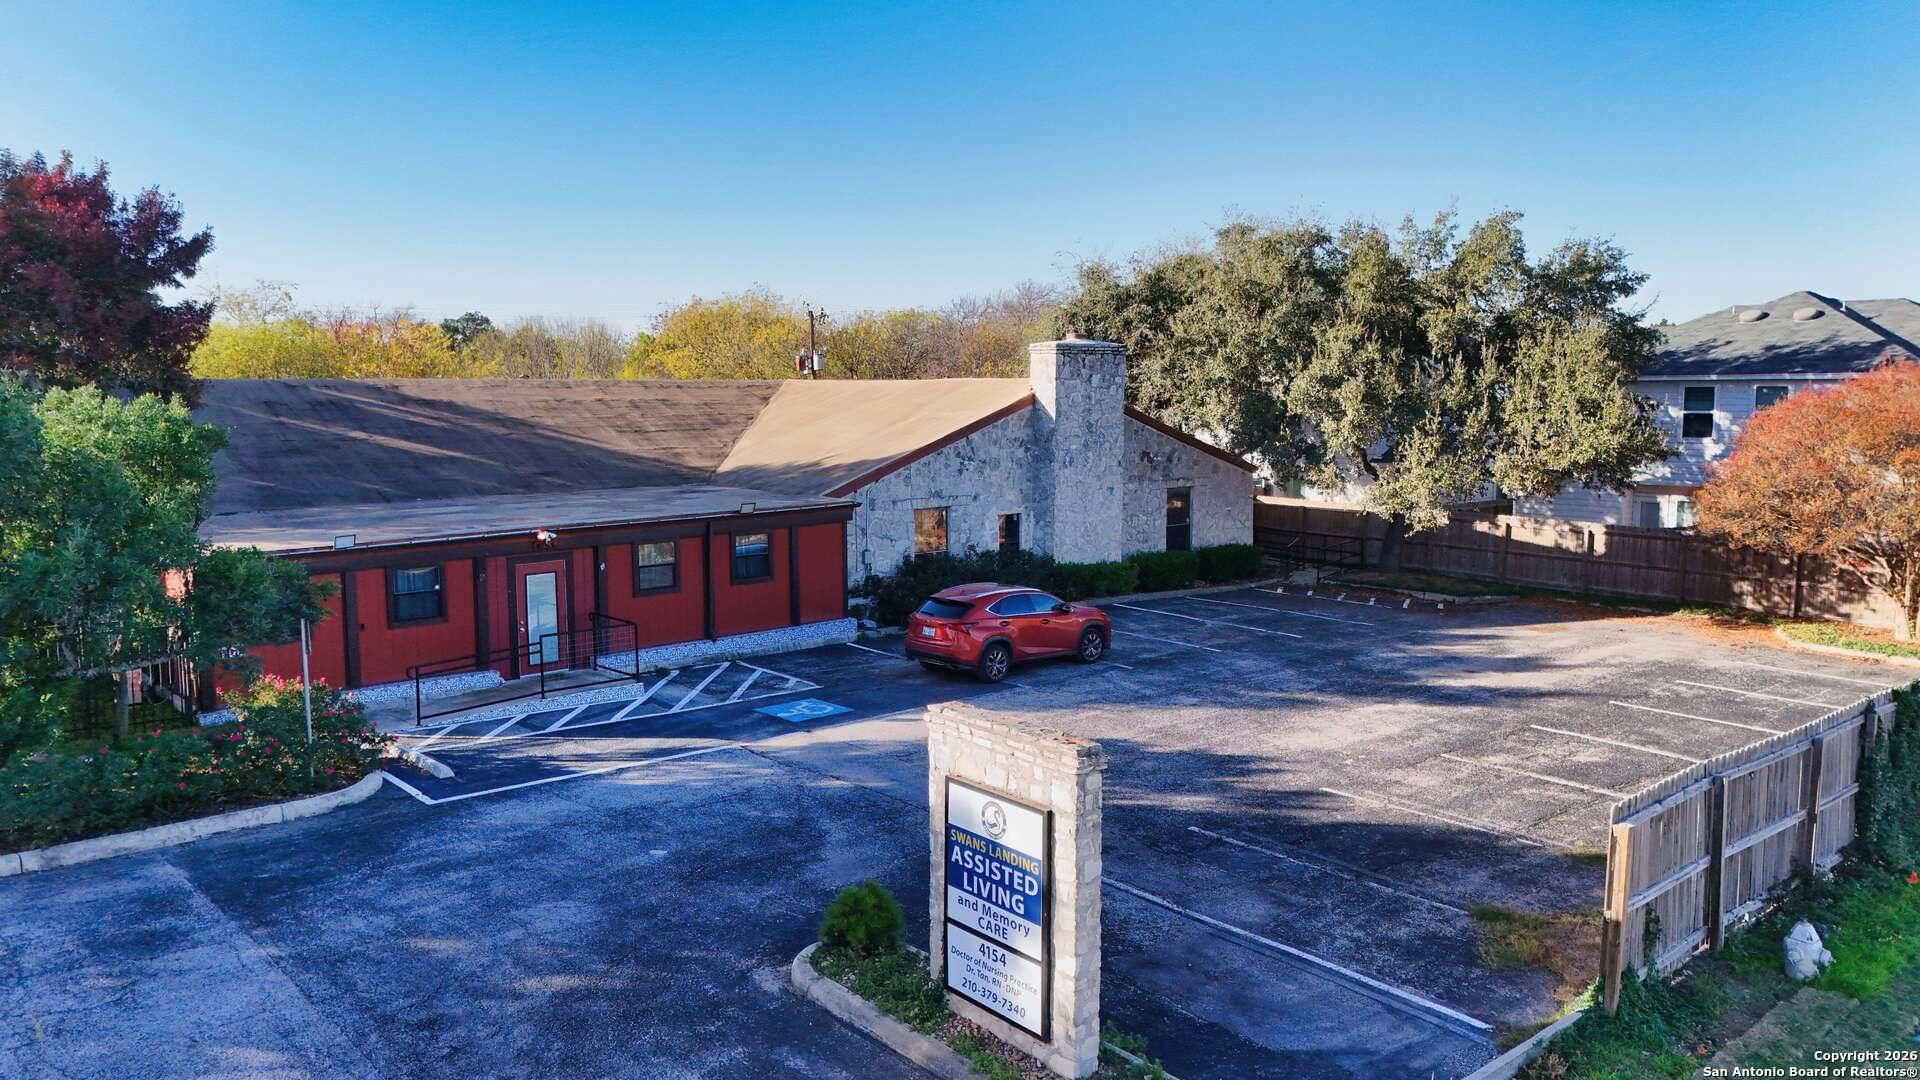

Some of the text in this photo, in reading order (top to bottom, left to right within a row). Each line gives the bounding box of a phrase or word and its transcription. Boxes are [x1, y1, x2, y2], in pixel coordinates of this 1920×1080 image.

[950, 829, 1039, 875] SWANS LANDING
[951, 845, 1038, 896] ASSISTED
[963, 871, 1025, 914] LIVING
[957, 895, 1030, 938] and Memory
[978, 916, 1008, 940] CARE
[951, 945, 1038, 995] Doctor of Nursing Practice
[966, 964, 975, 975] Dr.
[978, 943, 1007, 967] 4154
[961, 977, 1026, 1018] 210-379-7340
